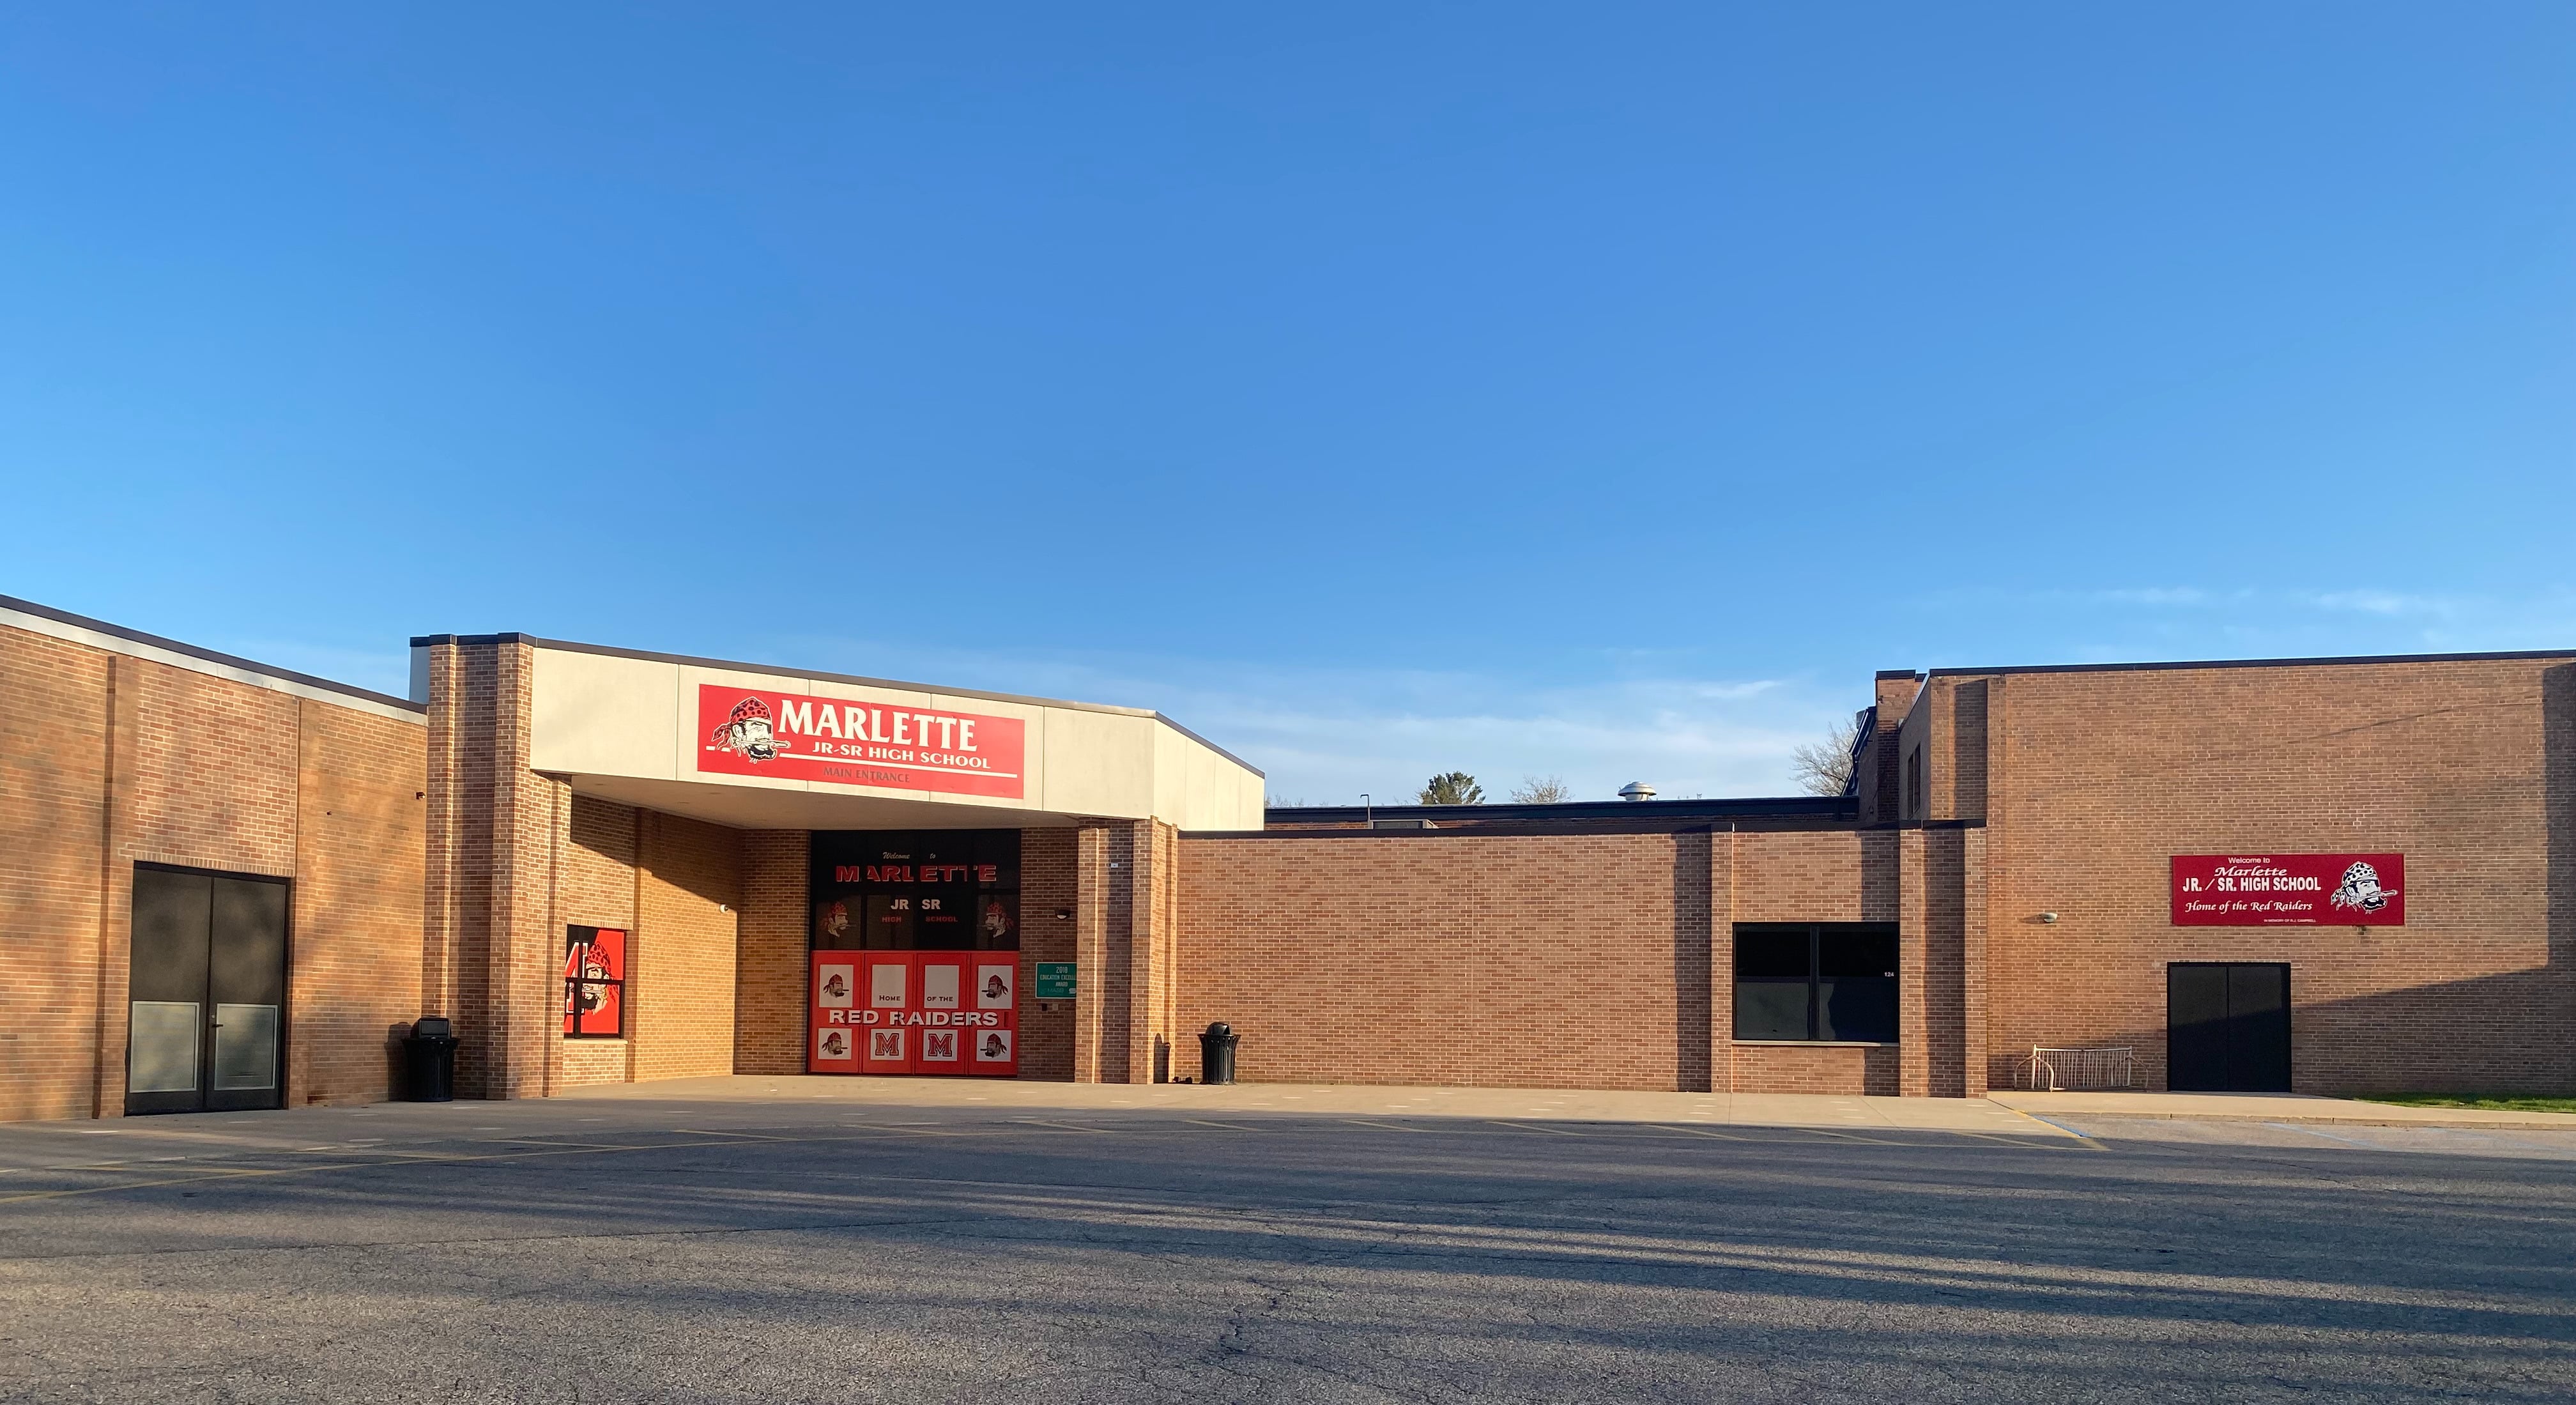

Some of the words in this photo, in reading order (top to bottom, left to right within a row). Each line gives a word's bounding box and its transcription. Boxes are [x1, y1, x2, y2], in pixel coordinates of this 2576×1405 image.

[778, 699, 977, 752] MARLETTE
[812, 741, 862, 756] JR-SR
[869, 746, 914, 762] HIGH
[920, 751, 991, 769] SCHOOL
[823, 767, 852, 778] MAIN
[855, 769, 910, 783] ENTRANCE
[882, 851, 910, 859] Welcome
[2214, 865, 2287, 877] Marlette
[2182, 877, 2202, 892] JR.
[2218, 877, 2237, 891] SR.
[2241, 877, 2270, 891] HIGH
[2273, 877, 2322, 891] SCHOOL
[891, 898, 909, 910] JR
[921, 898, 941, 910] SR
[2185, 900, 2216, 913] Home
[2219, 900, 2232, 914] of
[2232, 900, 2248, 911] the
[2250, 900, 2273, 912] Red
[2273, 900, 2313, 912] Raiders
[829, 1009, 880, 1025] RED
[889, 1011, 999, 1027] RAIDERS
[875, 1033, 900, 1056] M
[928, 1033, 953, 1057] M
